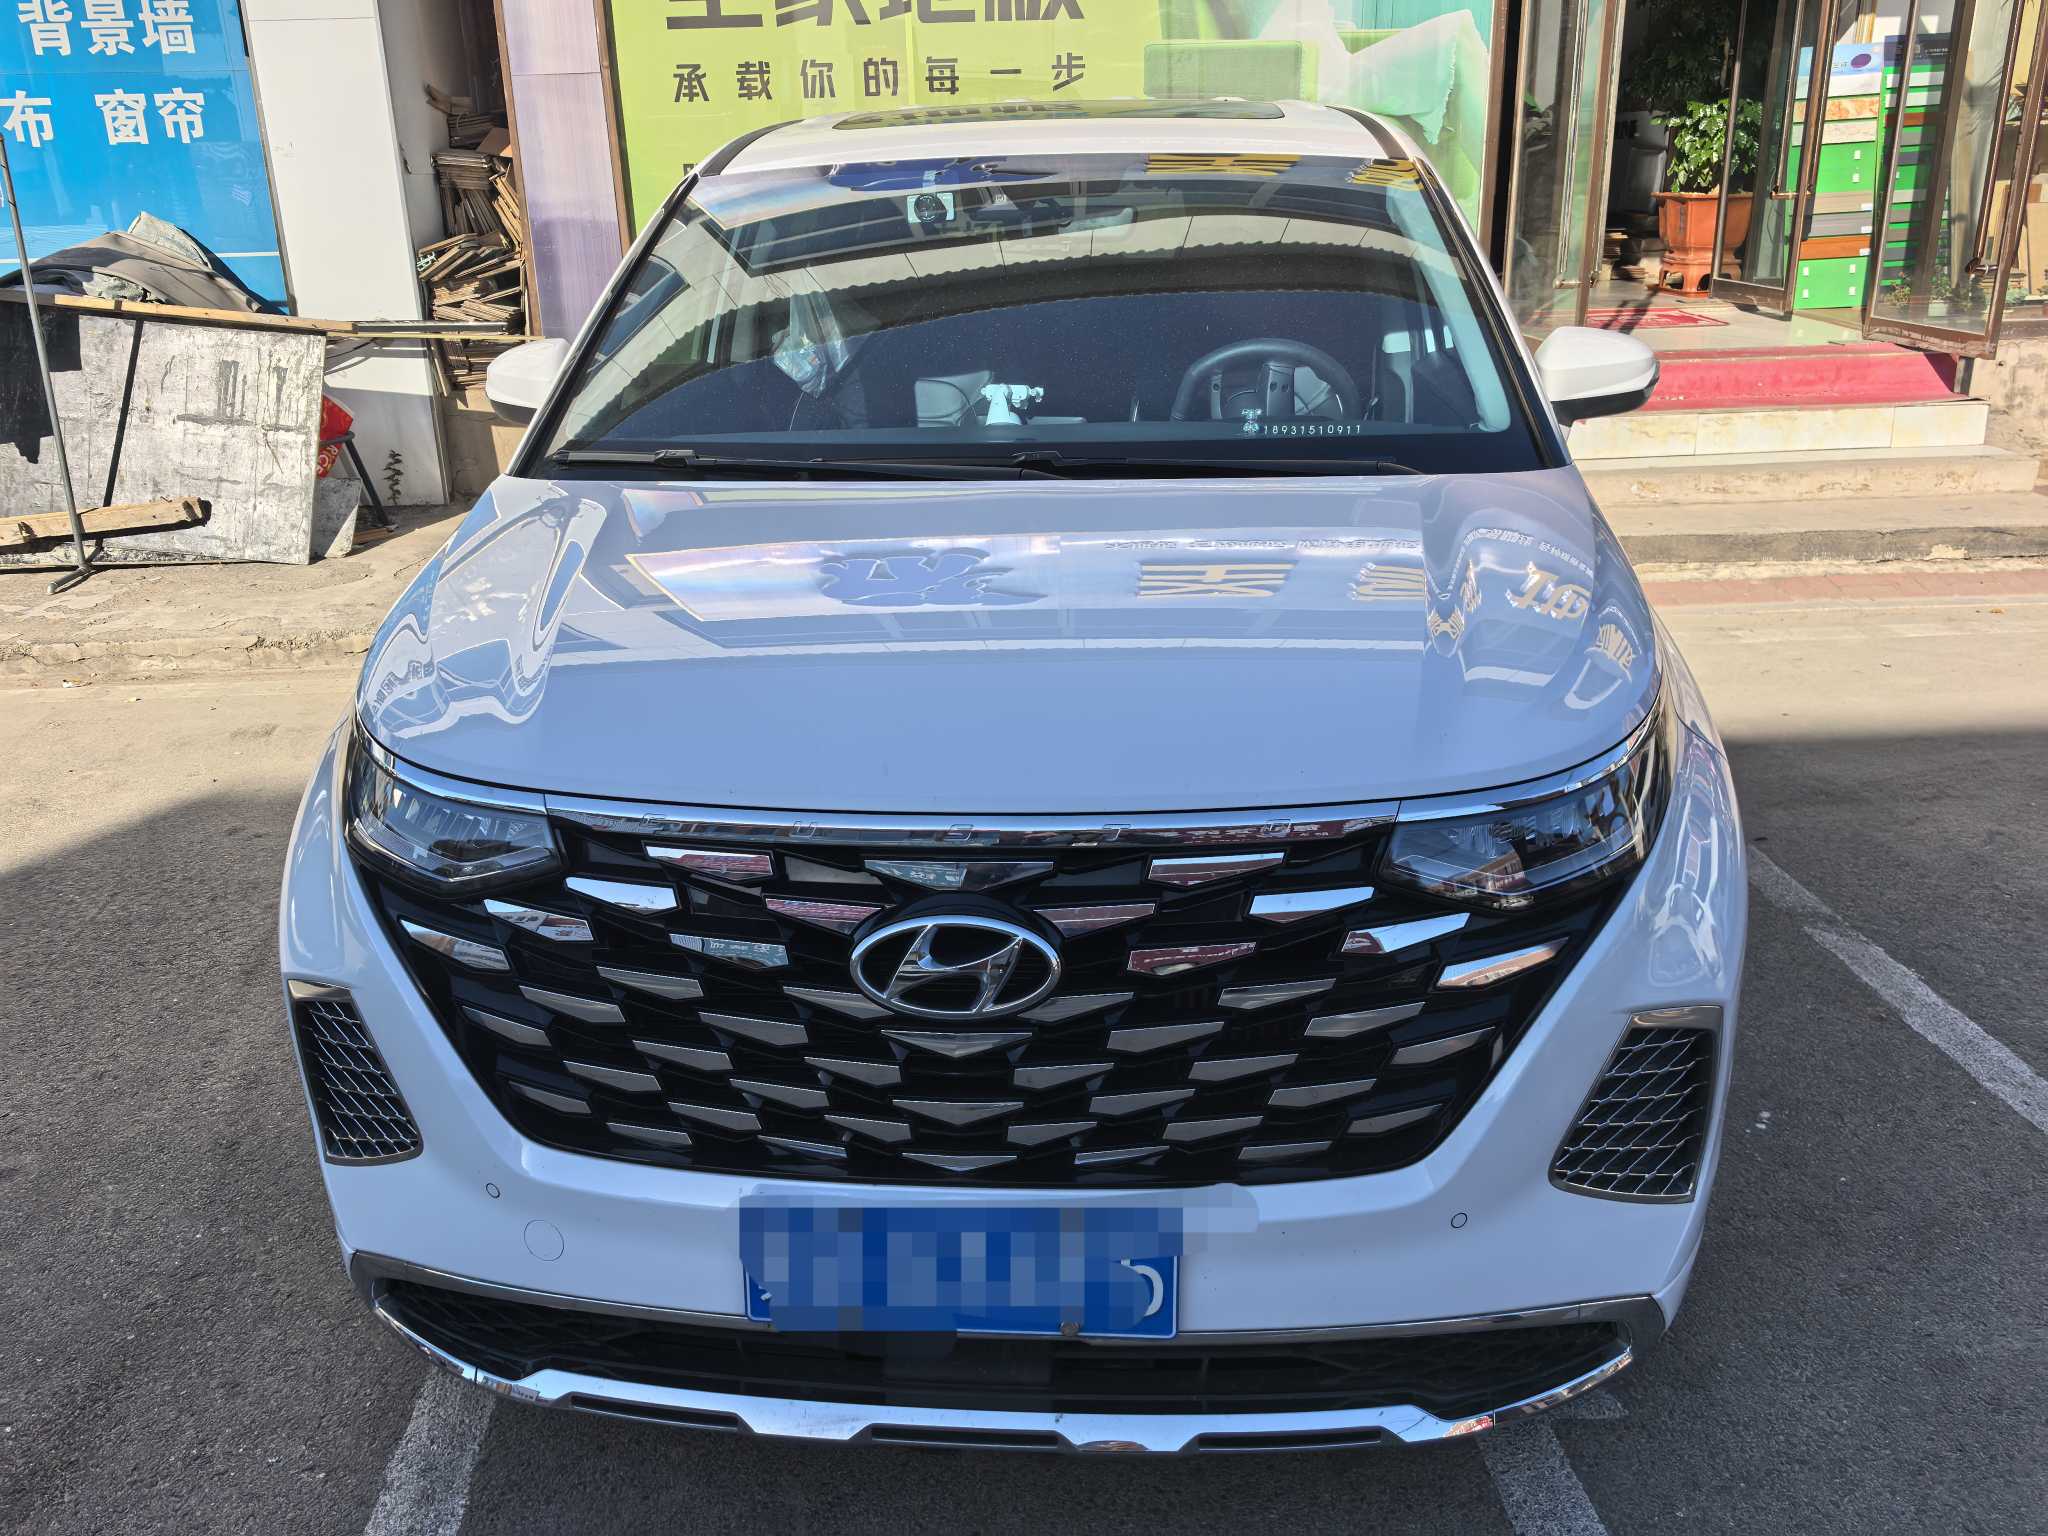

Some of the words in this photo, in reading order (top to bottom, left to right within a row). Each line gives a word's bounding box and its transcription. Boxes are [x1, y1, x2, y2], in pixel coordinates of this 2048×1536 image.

[17, 0, 196, 56] 背景墙
[672, 52, 1086, 103] 承载你的每一步
[0, 89, 54, 148] 布
[94, 87, 205, 146] 窗帘
